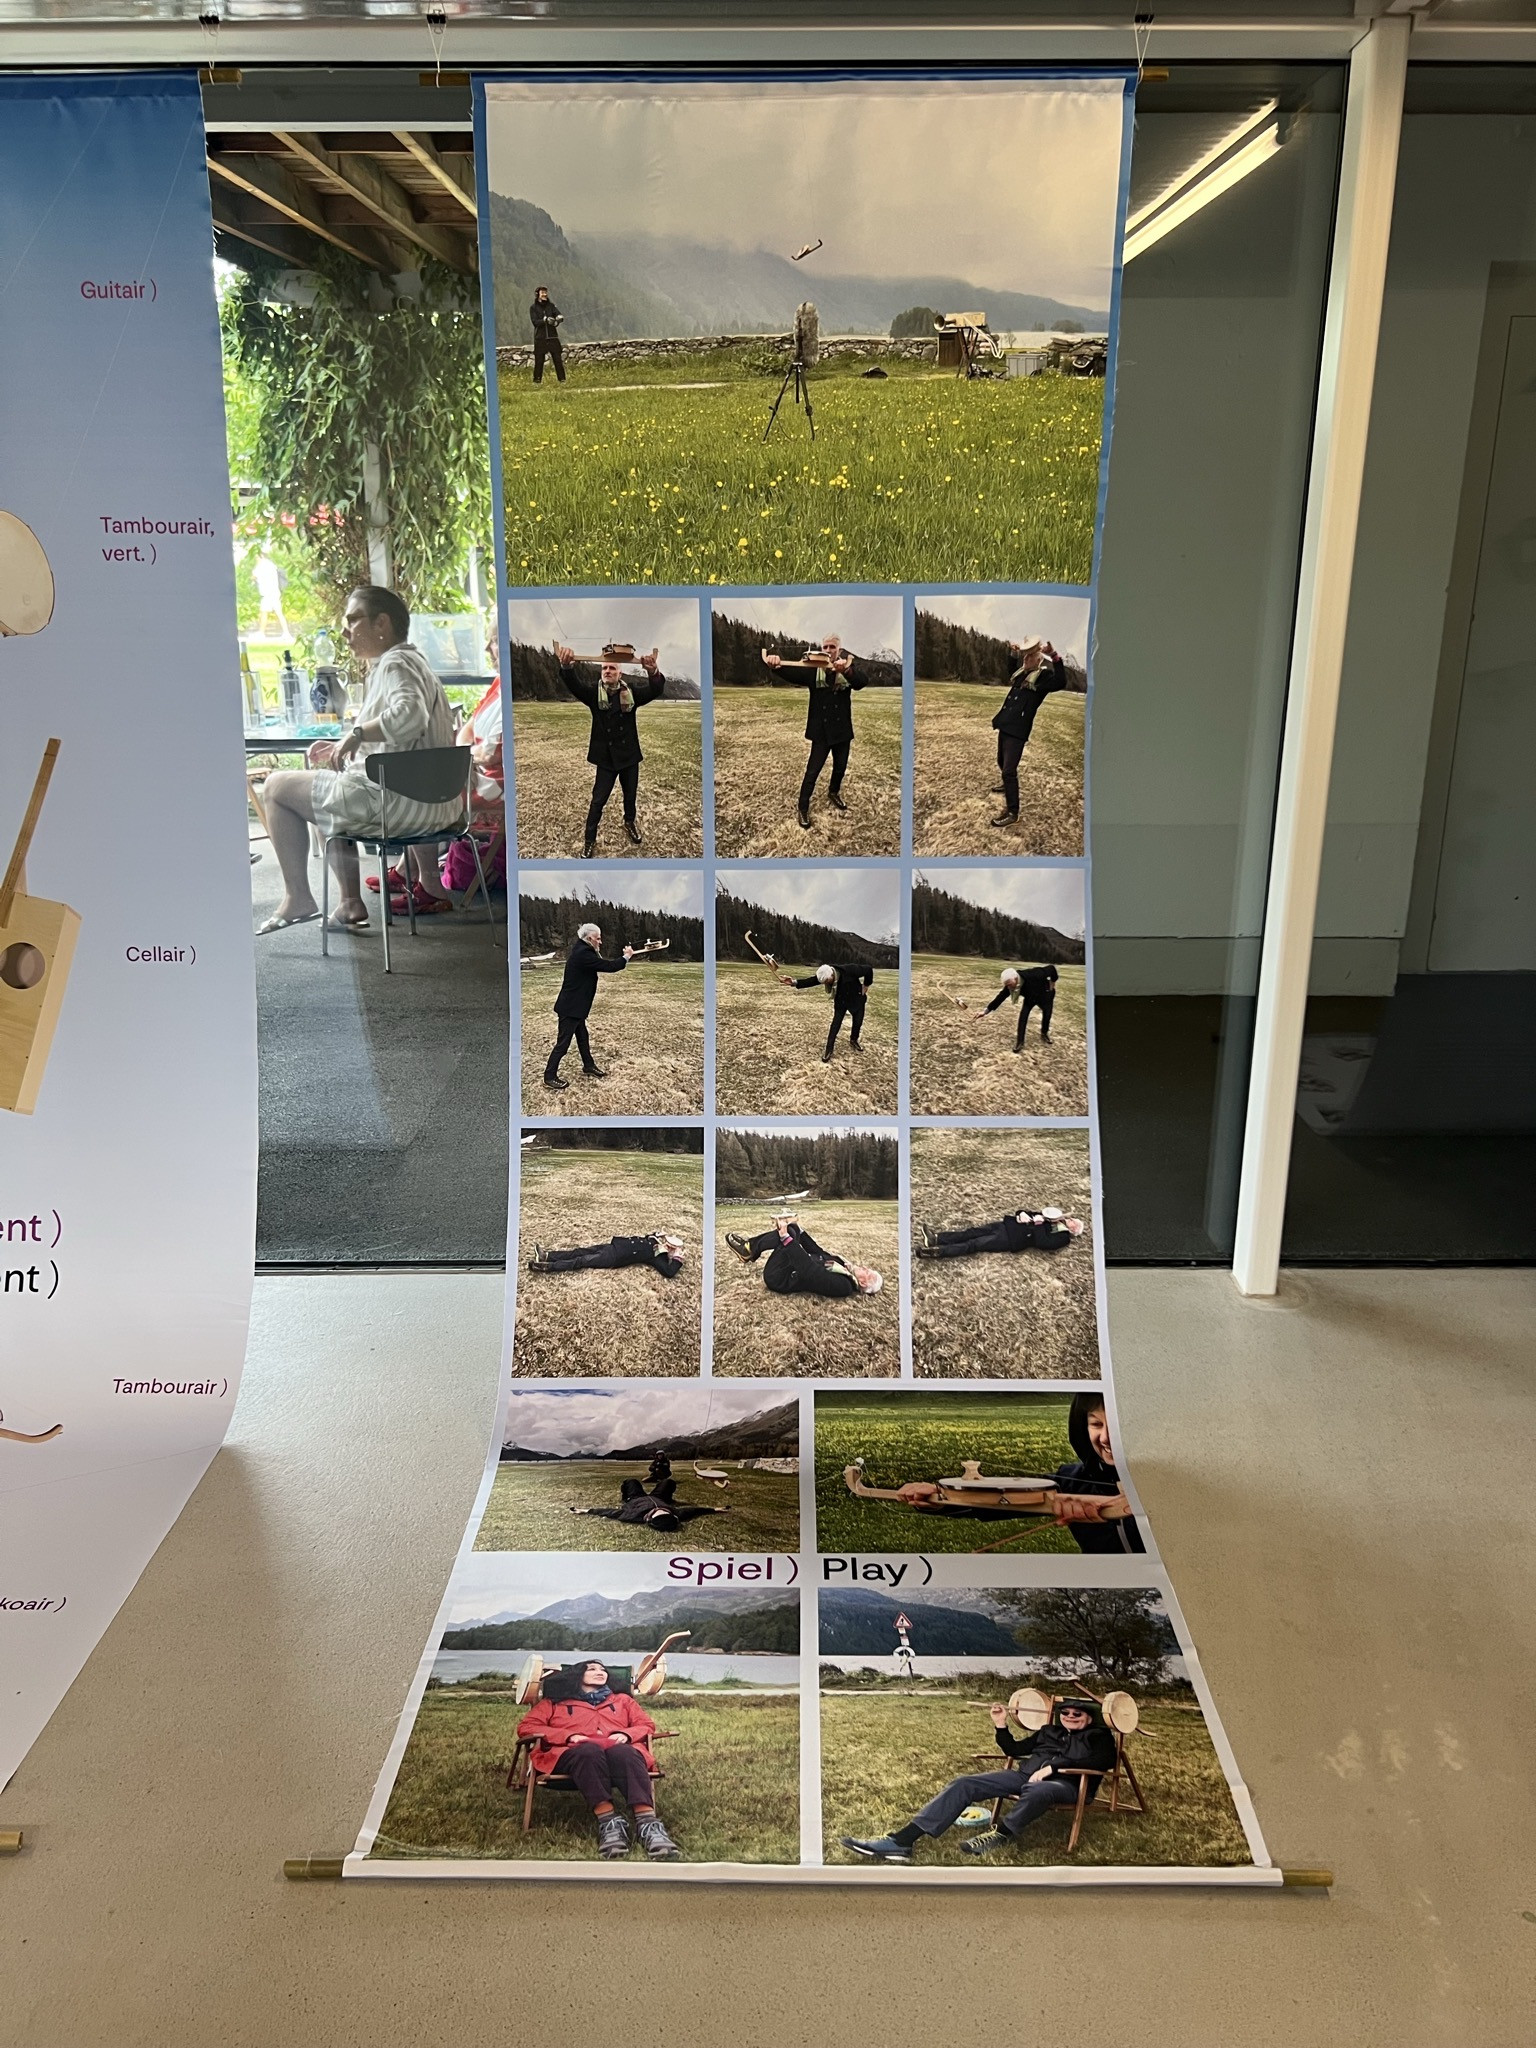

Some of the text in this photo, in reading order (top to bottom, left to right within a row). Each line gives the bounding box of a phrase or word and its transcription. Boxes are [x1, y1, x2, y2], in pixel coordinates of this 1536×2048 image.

[80, 280, 146, 299] Guitair
[99, 516, 215, 538] Tambourair,
[101, 546, 145, 562] vert.
[125, 945, 186, 962] Cellair
[0, 1214, 43, 1242] nt
[112, 1377, 218, 1395] Tambourair
[667, 1556, 773, 1586] Spiel
[822, 1556, 909, 1588] Play
